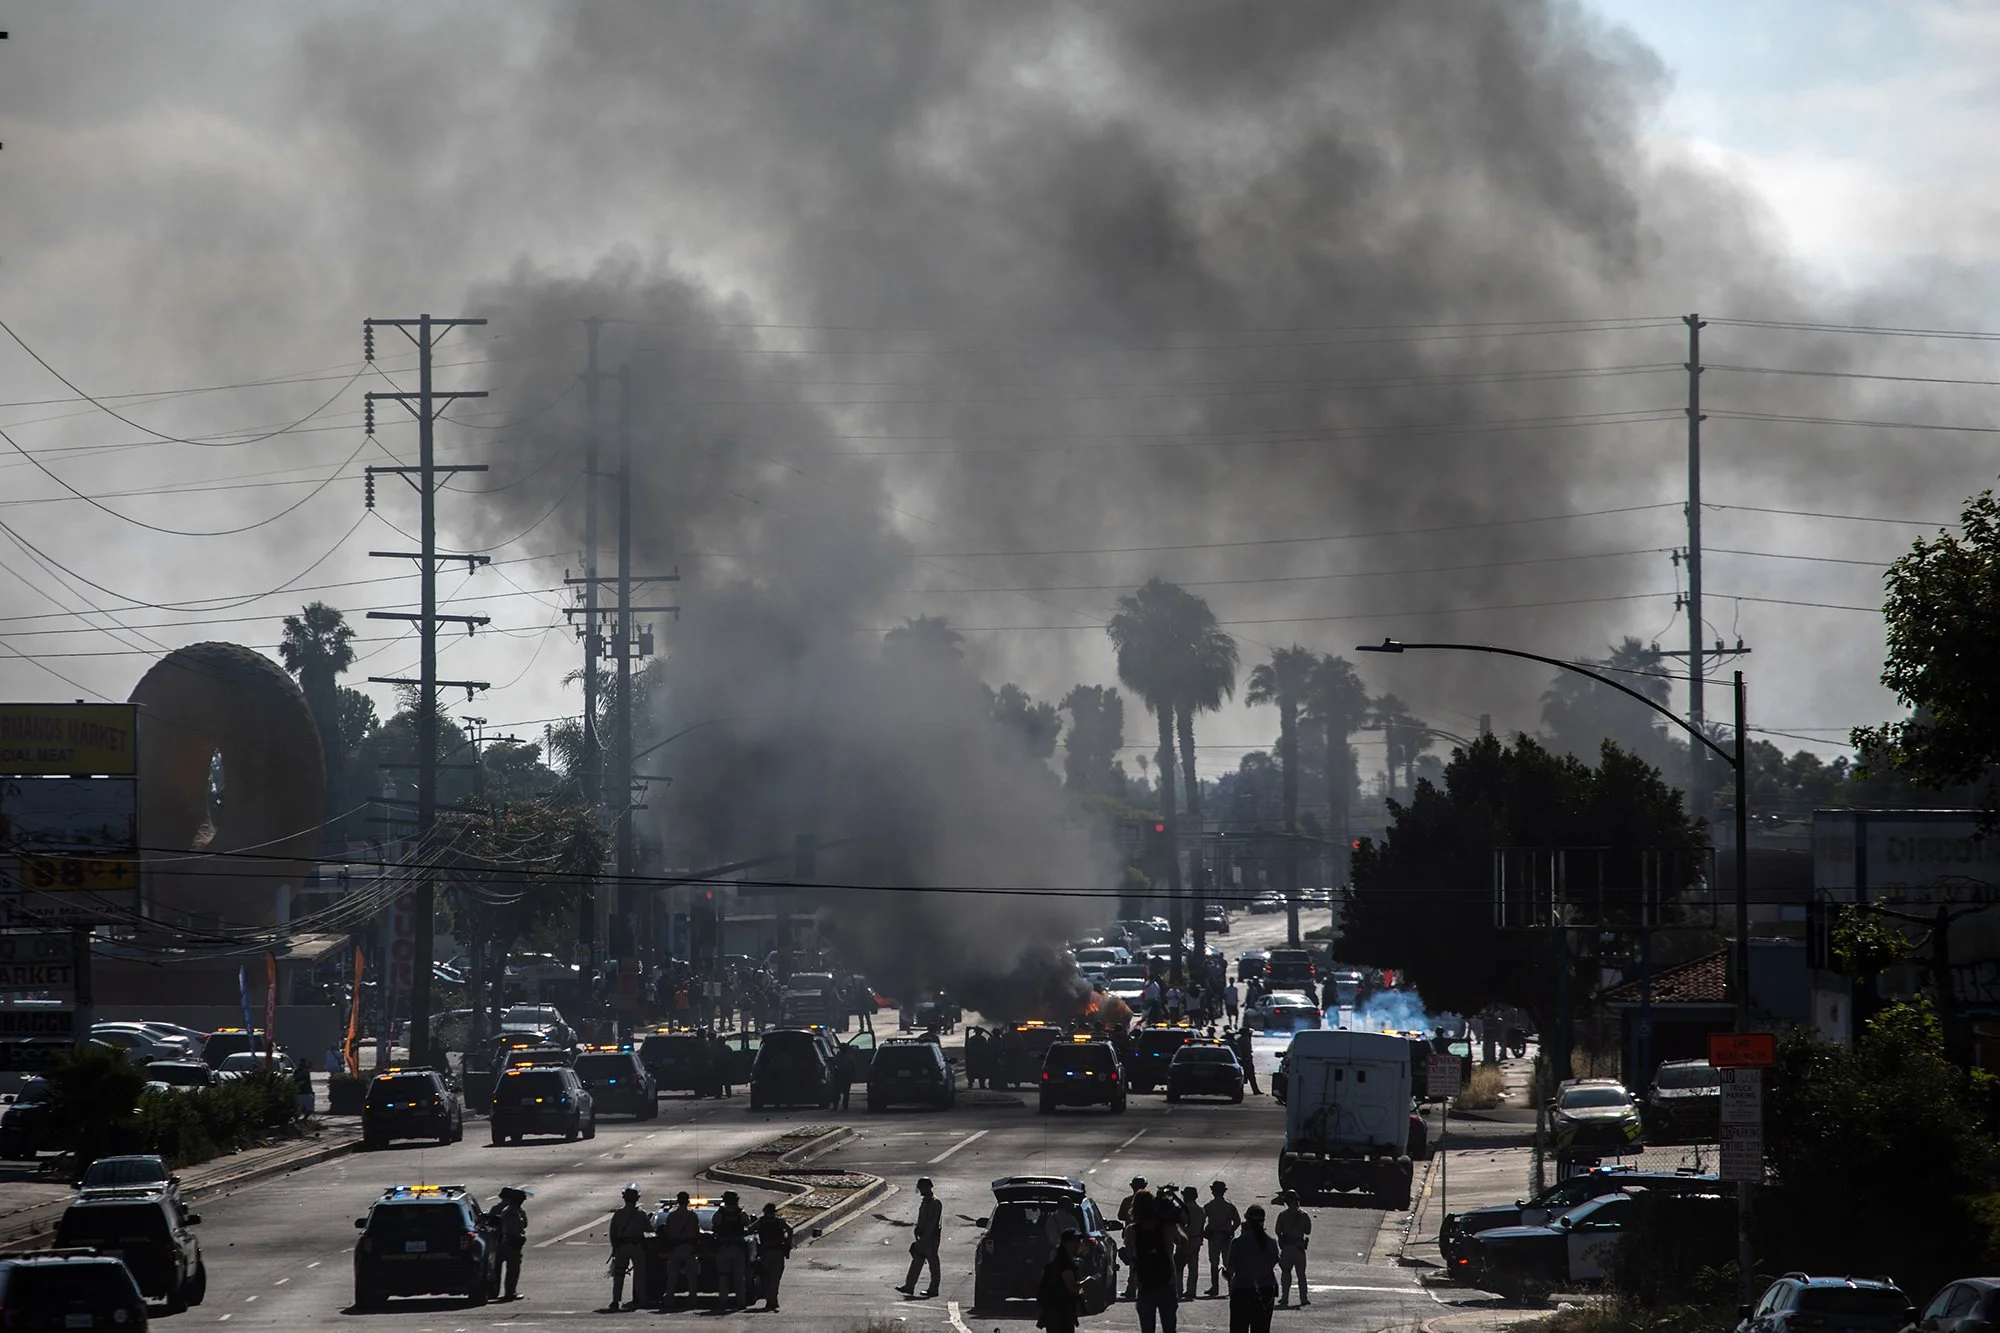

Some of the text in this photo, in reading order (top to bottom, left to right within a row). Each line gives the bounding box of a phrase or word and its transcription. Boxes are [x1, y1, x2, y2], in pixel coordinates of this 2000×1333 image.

[0, 715, 127, 754] RMANOS MARKET
[0, 749, 75, 762] CIAL MEAT
[0, 1012, 72, 1032] BACCO
[1721, 1069, 1734, 1083] NO
[1730, 1084, 1753, 1093] TRUCK
[1721, 1126, 1761, 1139] NO PARKING
[1721, 1141, 1761, 1152] ENTIRE CITY
